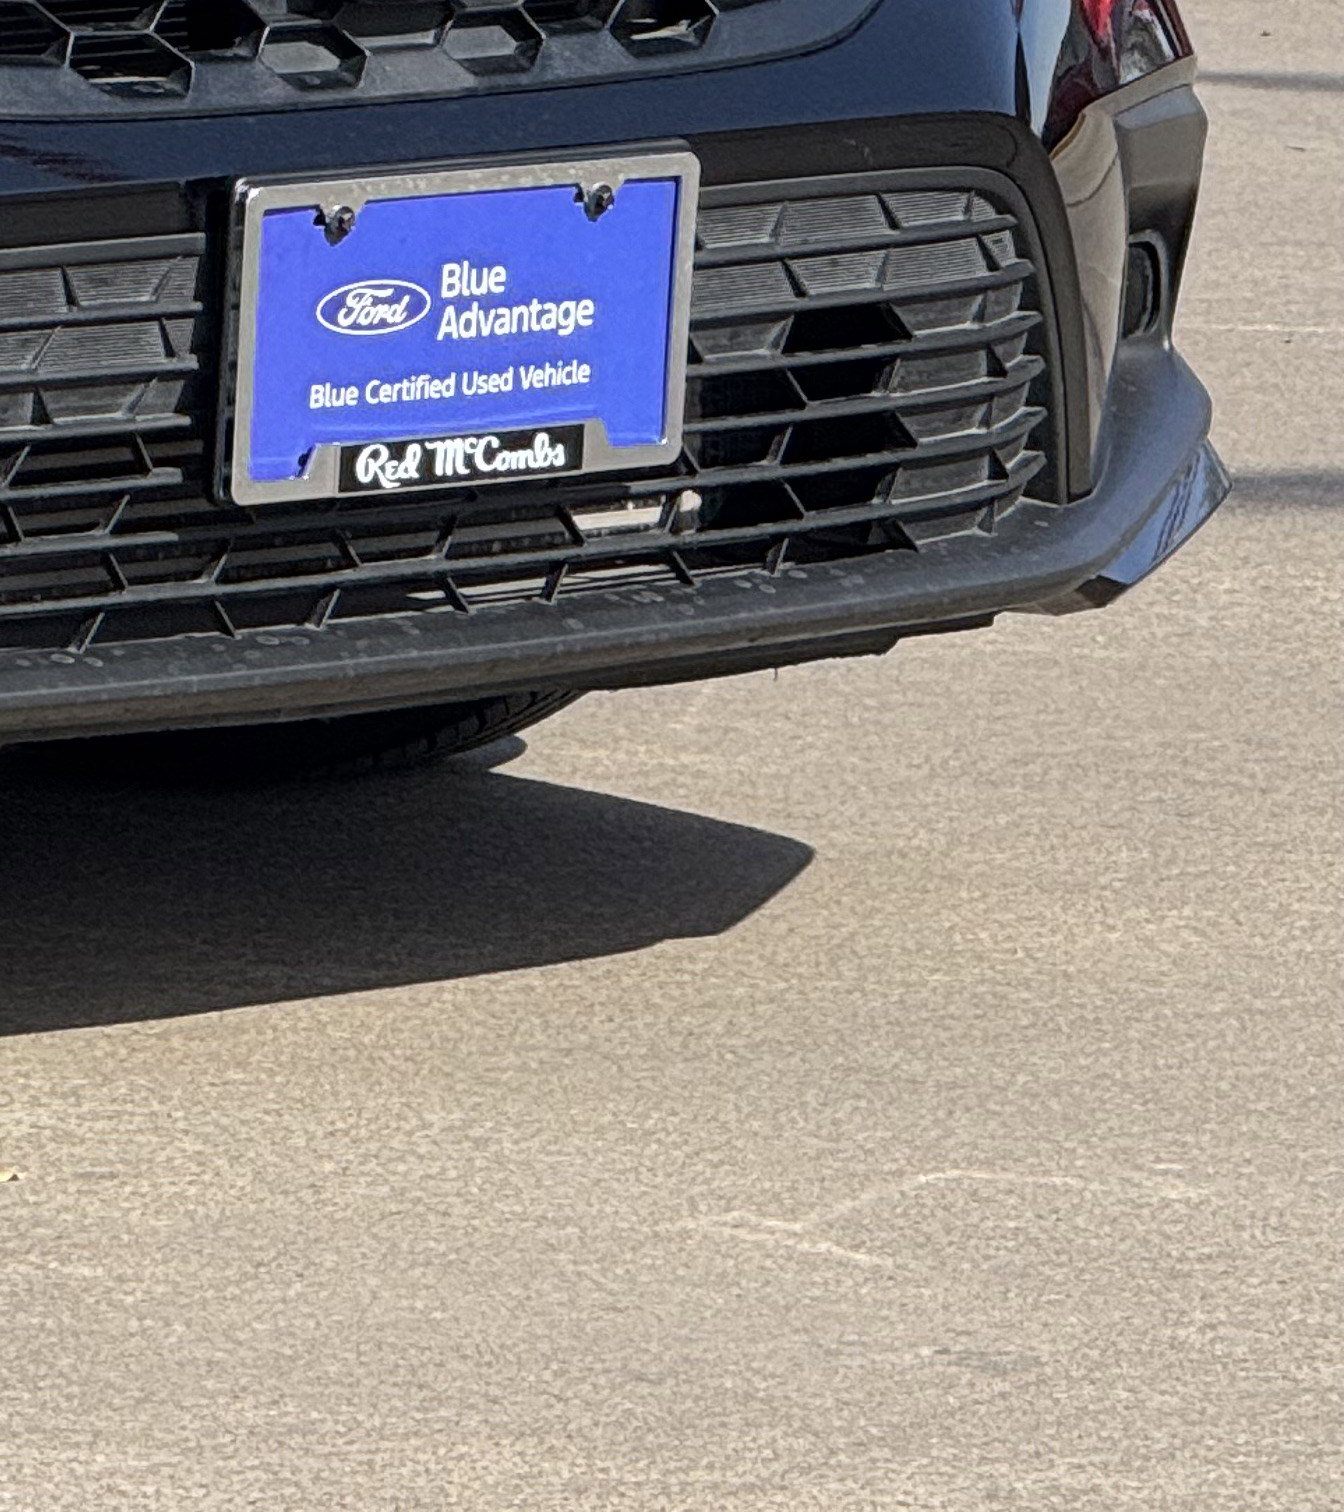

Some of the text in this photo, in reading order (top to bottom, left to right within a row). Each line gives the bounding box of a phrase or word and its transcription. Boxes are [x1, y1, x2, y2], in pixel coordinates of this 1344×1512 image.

[441, 261, 507, 299] Blue
[436, 297, 594, 341] Advantage
[309, 359, 591, 409] Blue Certified Used Vehicle
[426, 432, 566, 476] McCombs
